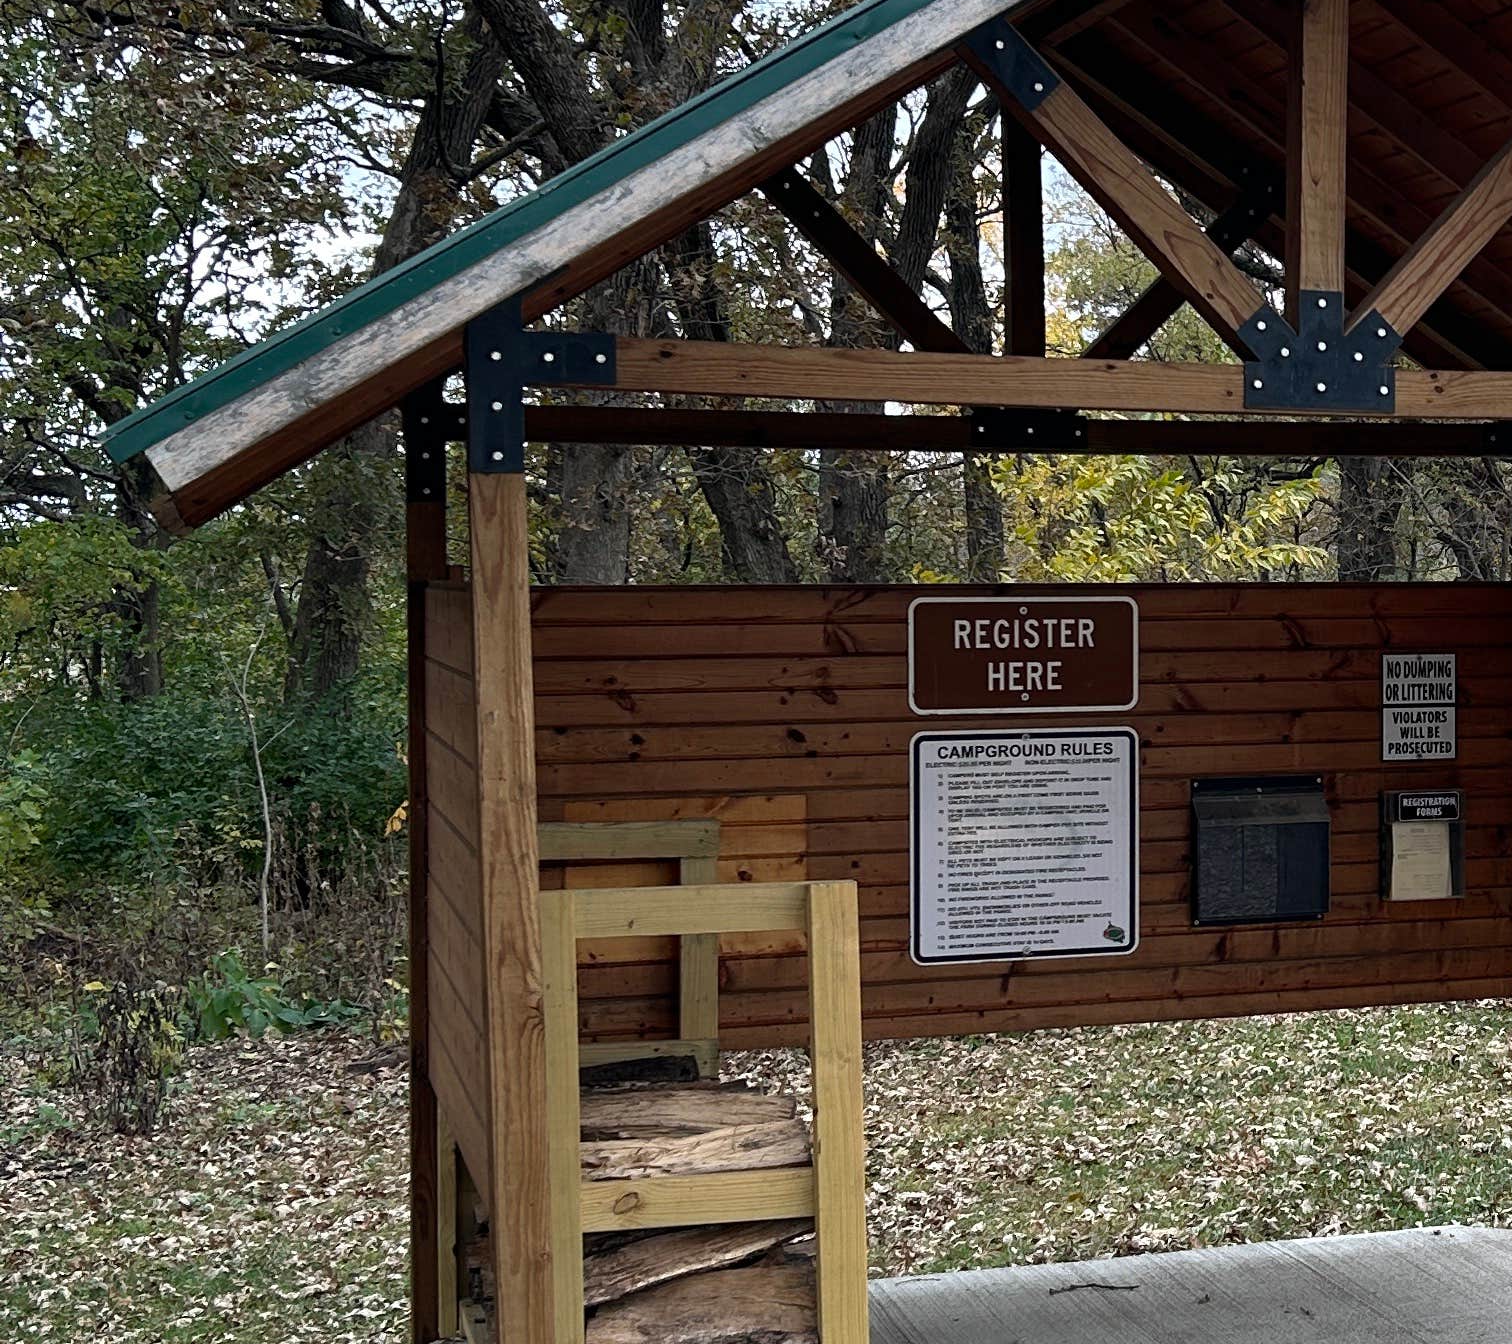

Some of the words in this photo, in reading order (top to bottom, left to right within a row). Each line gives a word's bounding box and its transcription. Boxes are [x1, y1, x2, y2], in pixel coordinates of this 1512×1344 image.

[953, 618, 1095, 649] REGISTER
[987, 661, 1062, 691] HERE
[1386, 660, 1401, 679] NO
[1404, 660, 1452, 678] DUMPING
[1385, 683, 1399, 701] OR
[1402, 682, 1453, 701] LITTERING
[1392, 711, 1448, 724] VIOLATORS
[1400, 726, 1425, 739] WILL
[1427, 726, 1440, 738] BE
[937, 743, 1056, 760] CAMPGROUND
[1060, 742, 1113, 756] RULES
[1388, 741, 1452, 754] PROSECUTED
[1402, 796, 1457, 807] REGISTRATION
[1416, 807, 1442, 816] FORMS
